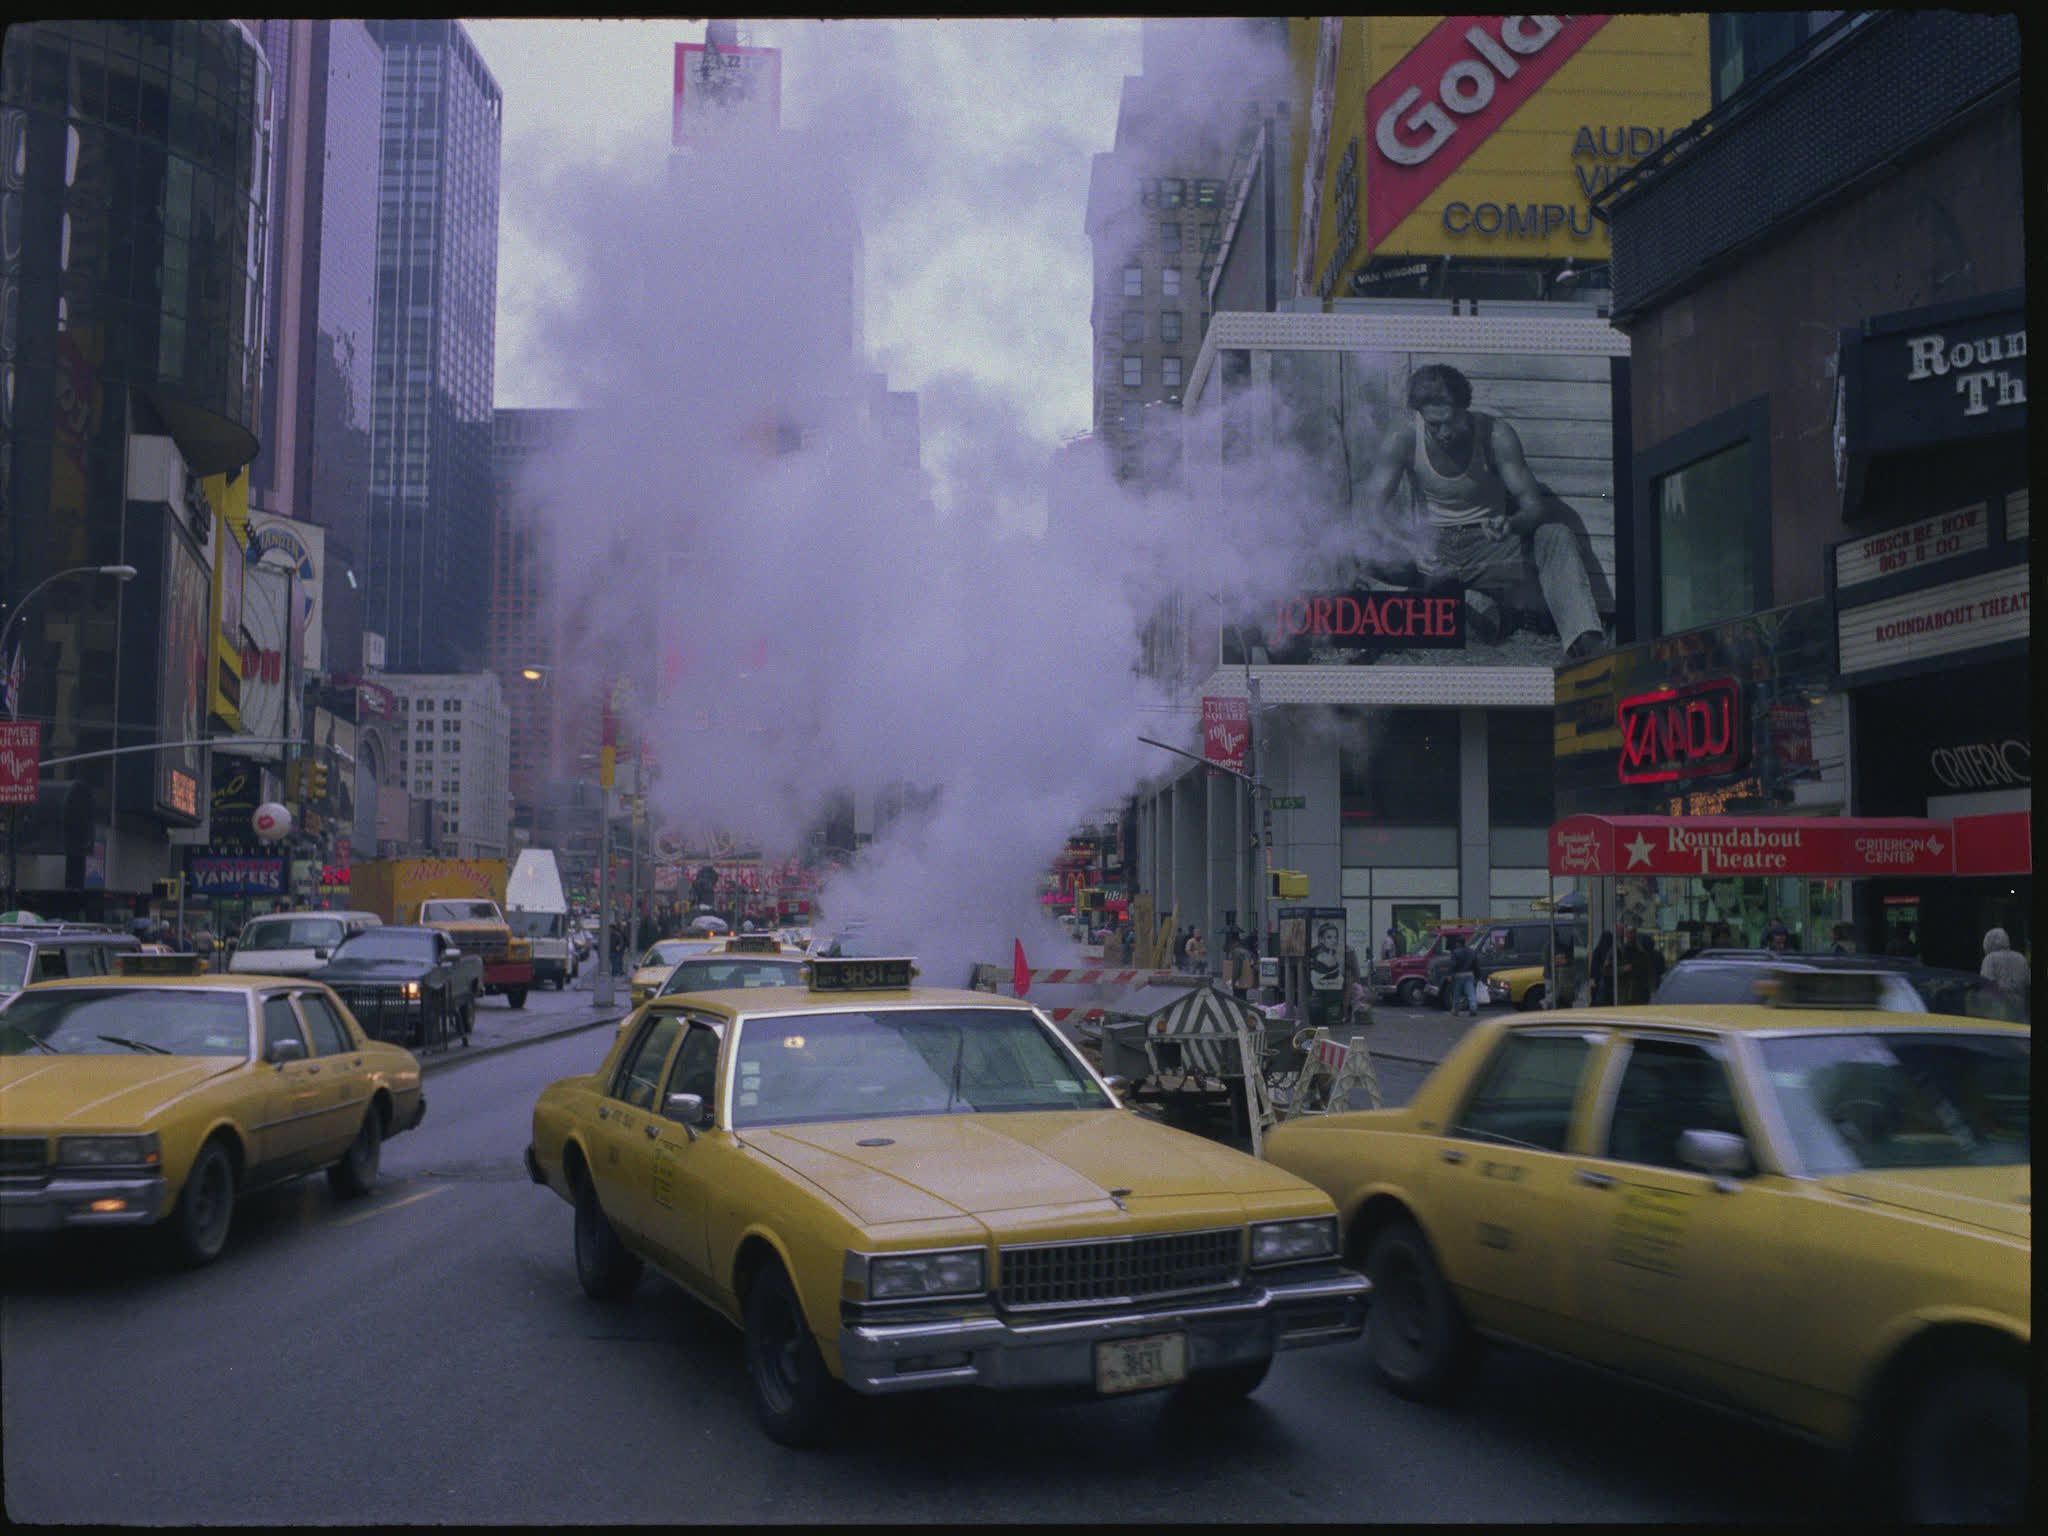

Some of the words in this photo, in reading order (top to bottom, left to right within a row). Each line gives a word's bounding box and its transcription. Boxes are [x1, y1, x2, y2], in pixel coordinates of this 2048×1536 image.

[1442, 202, 1609, 239] COMPU
[1906, 330, 2028, 381] Roun
[1956, 369, 2028, 416] Th
[1942, 510, 1977, 535] NOW
[1269, 595, 1457, 645] JORDACHE
[1875, 605, 1974, 642] ROUNDABOUT
[1980, 592, 2029, 619] THEAT
[1204, 702, 1246, 713] TIMES
[1204, 713, 1246, 722] SQUARE
[1622, 695, 1730, 767] XANADU
[1667, 825, 1801, 852] Roundabout
[1855, 836, 1925, 852] CRITERION
[1693, 846, 1787, 873] Theatre
[1865, 851, 1915, 864] CENTER
[193, 871, 280, 889] YANKEES
